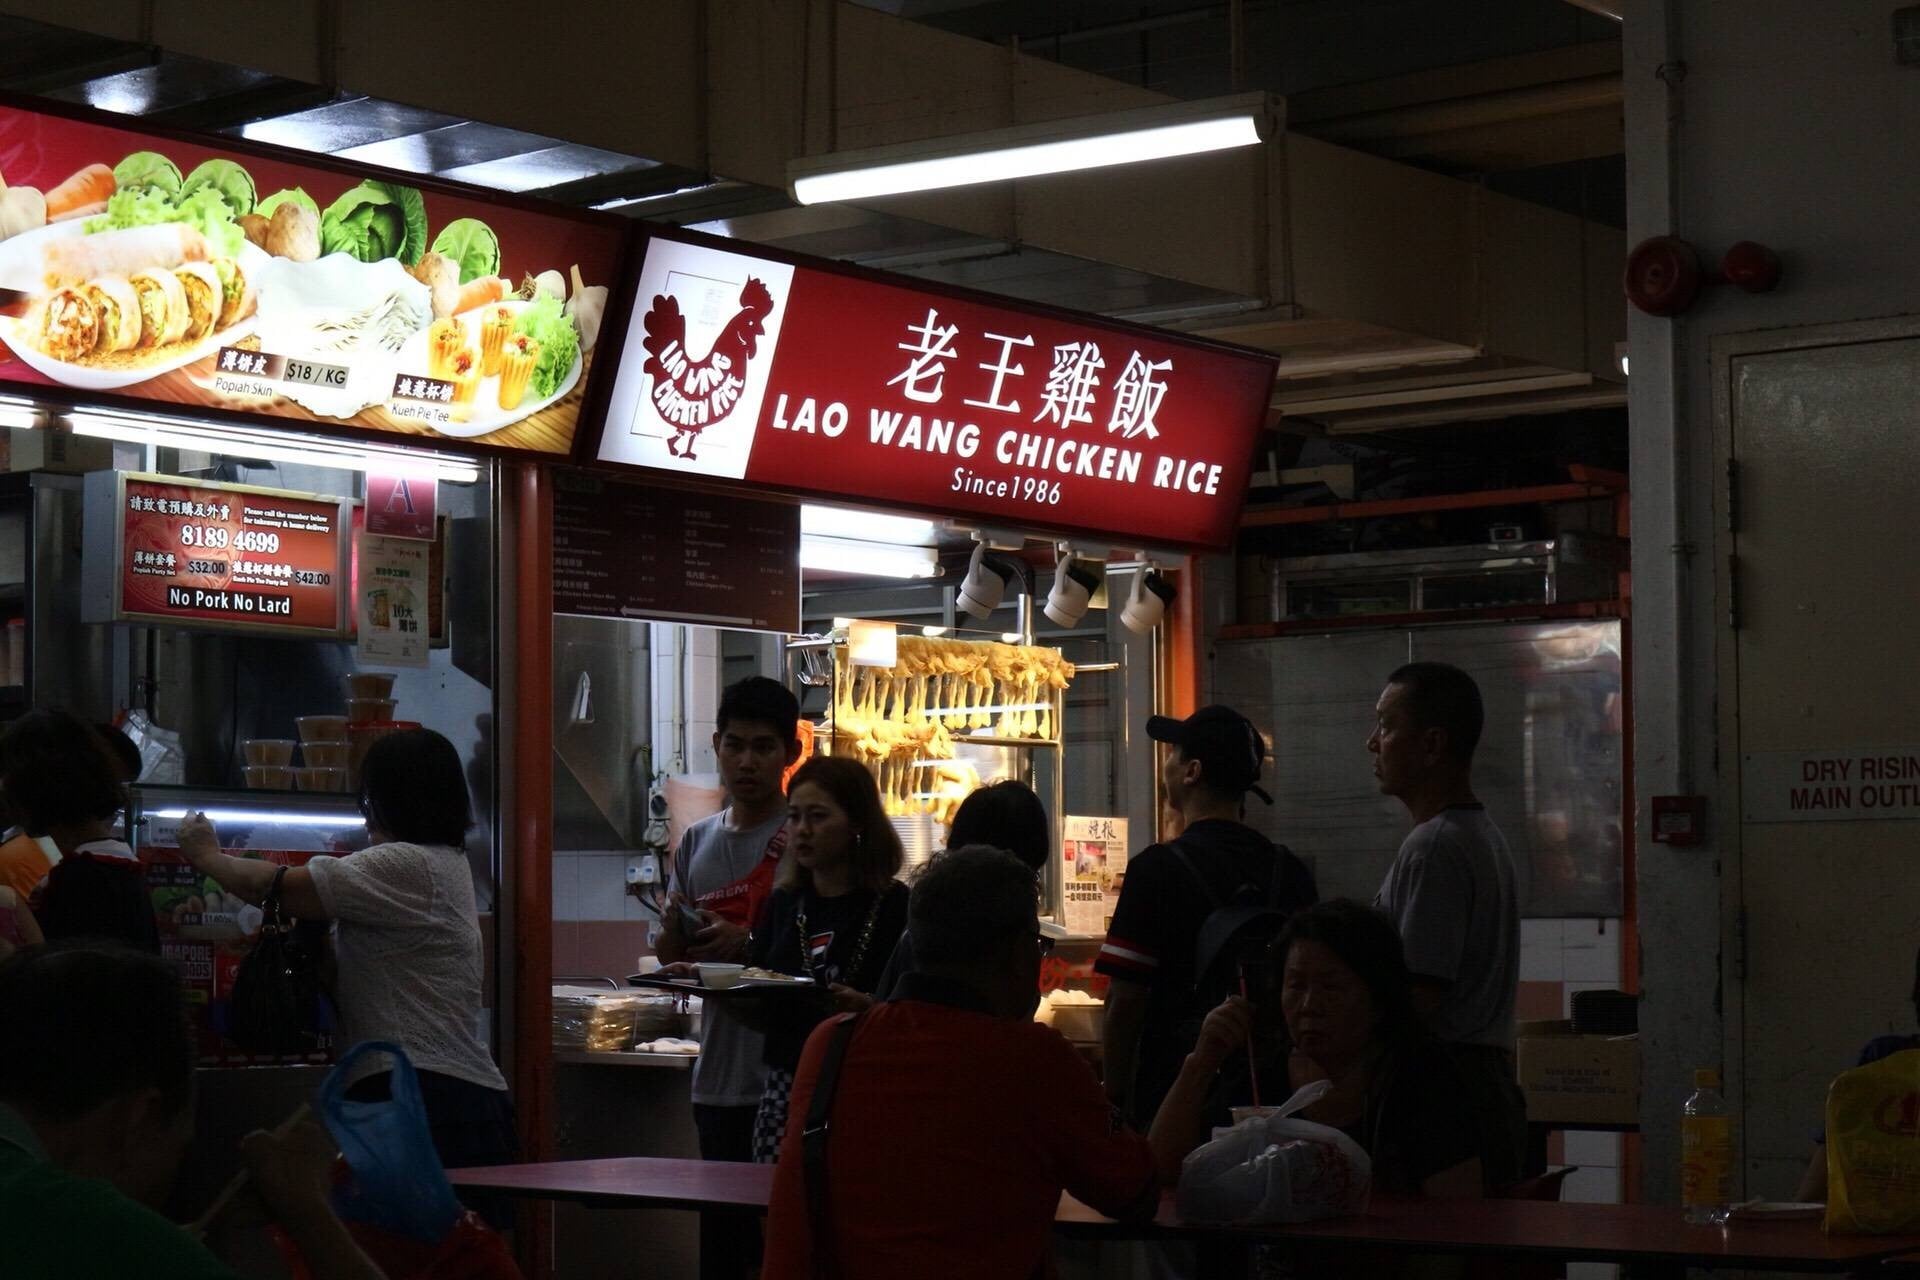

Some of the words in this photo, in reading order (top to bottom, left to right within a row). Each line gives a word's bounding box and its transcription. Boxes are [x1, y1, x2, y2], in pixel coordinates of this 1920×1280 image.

[287, 362, 312, 380] $18
[325, 369, 347, 386] KG
[659, 340, 687, 380] LAO
[684, 352, 732, 396] WANG
[886, 308, 1173, 440] 老王雞飯
[216, 377, 250, 394] Popiah
[251, 382, 273, 397] Skin
[654, 379, 709, 425] CHICKEN
[711, 373, 744, 416] RICE
[392, 403, 416, 417] Kueh
[417, 406, 431, 419] Pie
[433, 409, 450, 422] Tee
[772, 393, 849, 438] LAO
[870, 408, 981, 458] WANG
[996, 430, 1143, 483] CHICKEN
[1153, 455, 1223, 495] RICE
[384, 478, 416, 514] A
[244, 507, 264, 516] Please
[310, 514, 328, 522] below
[253, 518, 282, 528] takeaway
[289, 521, 305, 529] home
[306, 523, 330, 533] delivery
[181, 525, 229, 548] 8189
[233, 530, 280, 553] 4699
[189, 561, 225, 574] $32.00
[295, 571, 330, 585] $42.00
[170, 588, 190, 606] No
[196, 590, 229, 609] Pork
[234, 594, 254, 611] No
[259, 596, 291, 614] Lard
[1803, 758, 1852, 782] DRY
[1791, 787, 1851, 810] MAIN
